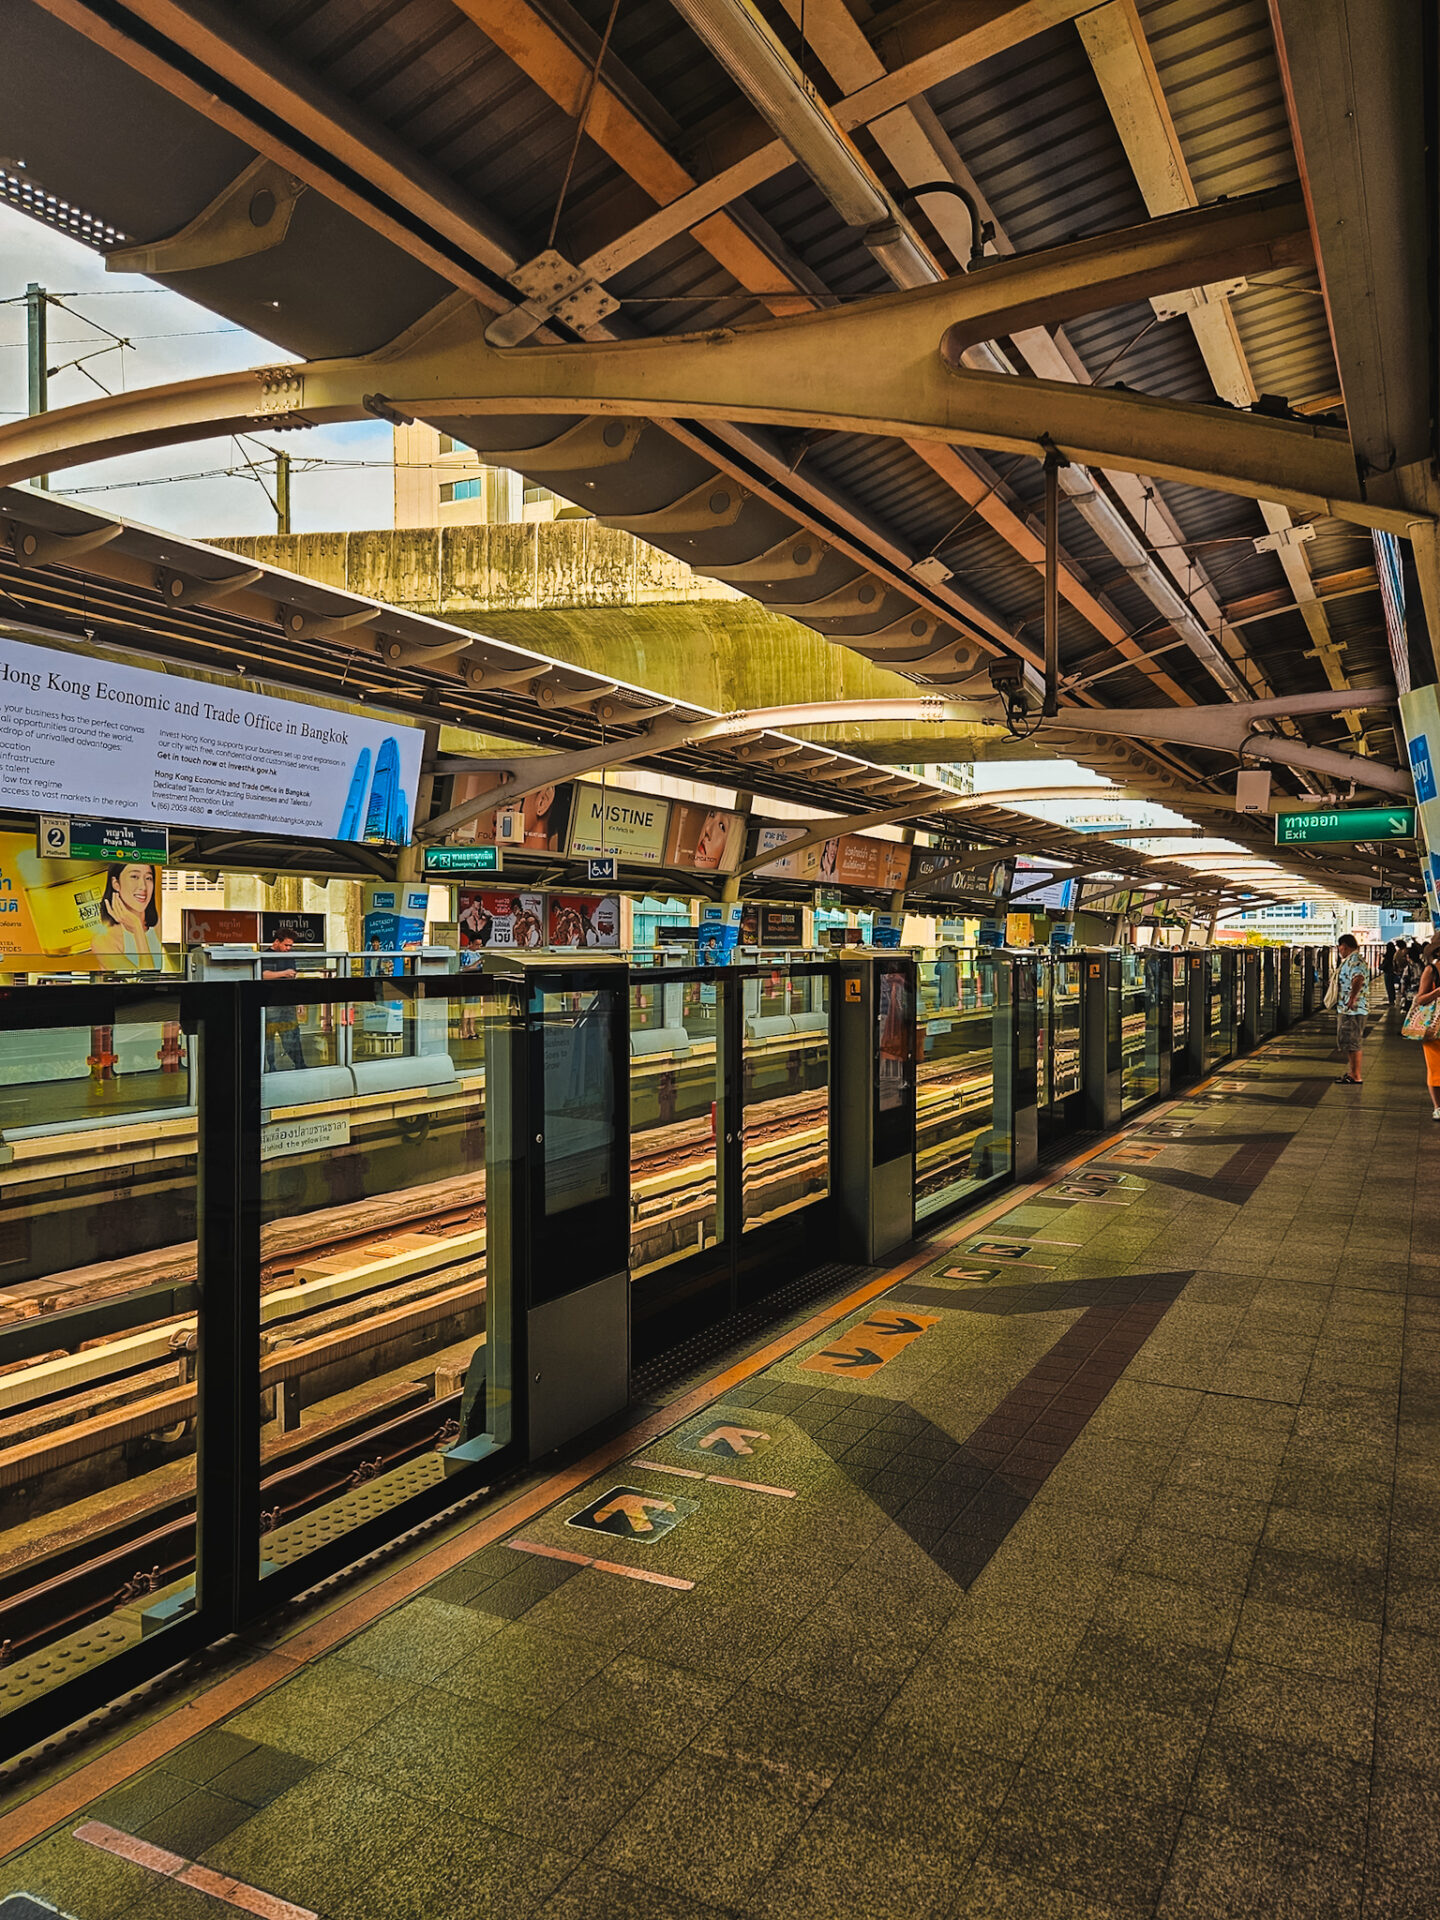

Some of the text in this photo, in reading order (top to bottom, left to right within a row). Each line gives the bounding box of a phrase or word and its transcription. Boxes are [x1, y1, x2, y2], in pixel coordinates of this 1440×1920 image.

[0, 662, 349, 745] Hong Kong Economic and Trade Office in Bangkok
[13, 717, 67, 732] opportunities
[69, 727, 97, 737] around
[98, 730, 111, 738] the
[26, 706, 59, 719] business
[61, 712, 75, 723] has
[77, 715, 90, 725] the
[91, 718, 119, 731] perfect
[120, 723, 145, 734] canvas
[25, 730, 34, 738] of
[36, 732, 74, 744] unrivalled
[181, 733, 198, 744] Hong
[200, 736, 216, 746] Kong
[217, 740, 243, 750] supports
[157, 751, 171, 760] Get
[172, 753, 180, 761] in
[182, 755, 202, 764] touch
[219, 760, 226, 768] at
[6, 764, 30, 774] talent
[2, 774, 63, 788] low tax regime
[154, 770, 174, 780] Hong
[175, 772, 193, 783] Kong
[194, 776, 227, 786] Economic
[242, 782, 258, 790] Trade
[285, 788, 310, 798] Bangkok
[1, 786, 30, 796] access
[32, 788, 40, 797] to
[42, 791, 58, 800] vast
[60, 792, 92, 802] markets
[102, 796, 114, 805] the
[115, 798, 138, 808] region
[591, 803, 654, 827] MISTINE
[1285, 814, 1338, 828] ทางออก
[52, 830, 62, 846] 2
[103, 838, 122, 847] Phaya
[1285, 830, 1306, 840] Exit
[279, 915, 309, 931] พญาไท
[286, 1140, 300, 1148] the
[301, 1138, 318, 1148] yellow
